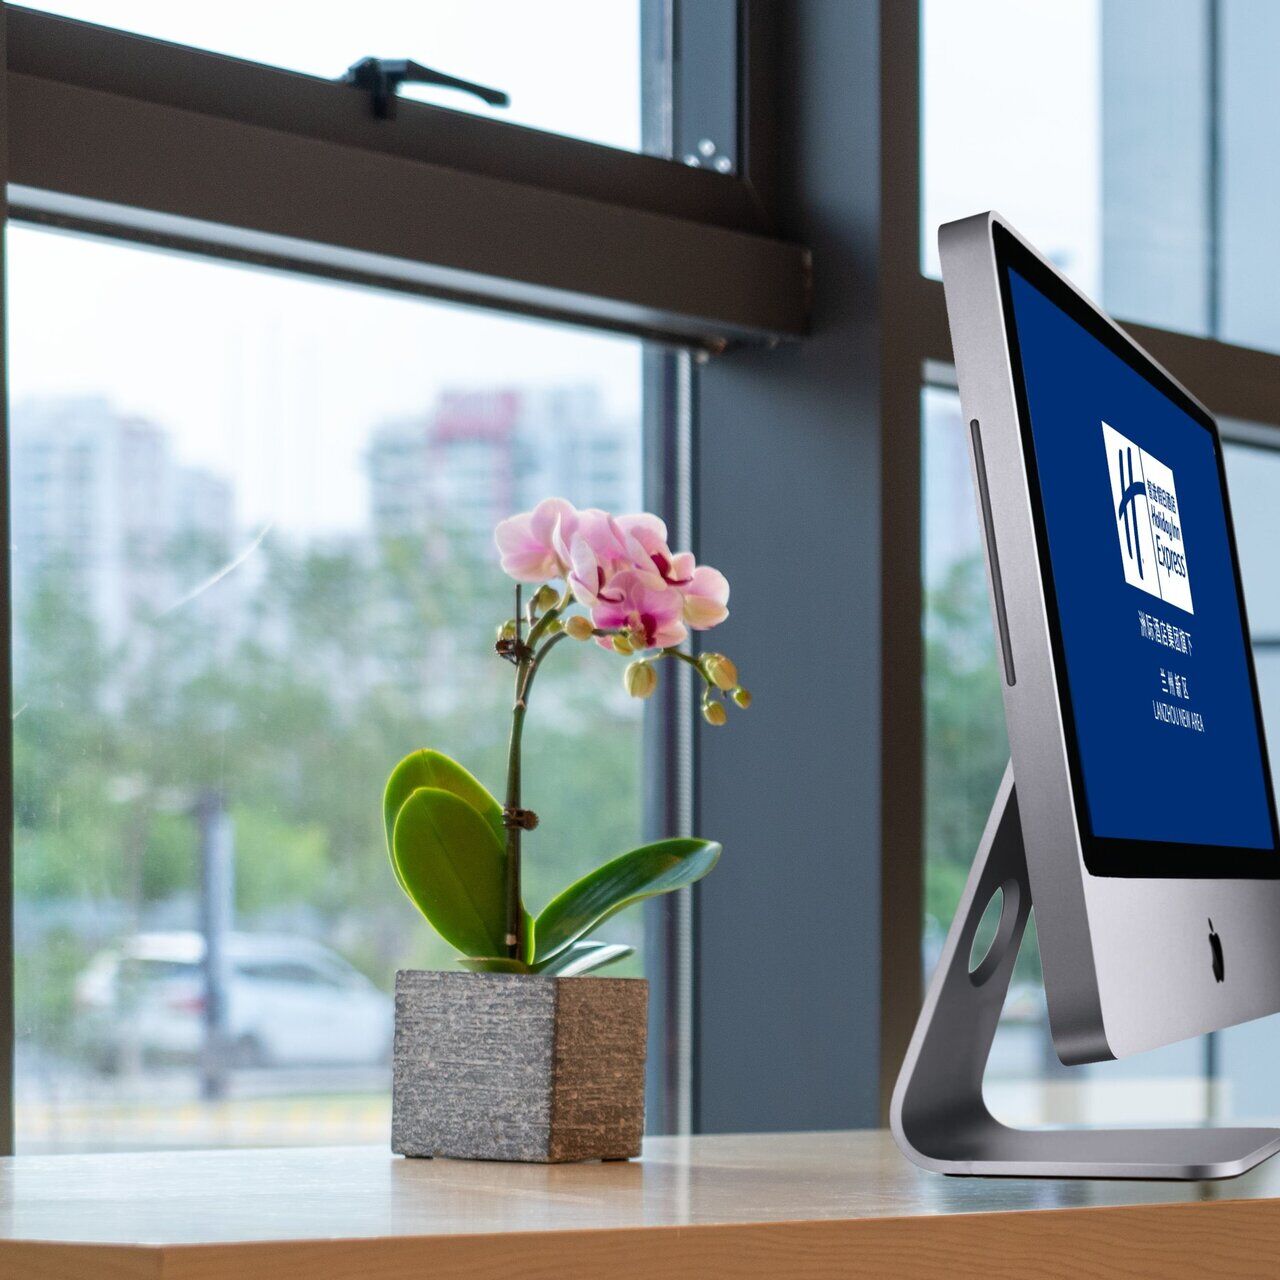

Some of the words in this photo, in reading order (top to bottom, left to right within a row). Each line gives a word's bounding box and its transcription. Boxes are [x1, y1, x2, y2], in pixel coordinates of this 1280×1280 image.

[1151, 504, 1172, 541] Holiday
[1156, 534, 1186, 578] Express
[1138, 610, 1192, 656] 洲际酒店集团旗下
[1160, 667, 1190, 700] 兰州新区
[1152, 700, 1180, 726] LANZHOU
[1180, 708, 1191, 729] NEW
[1191, 712, 1205, 733] AREA
